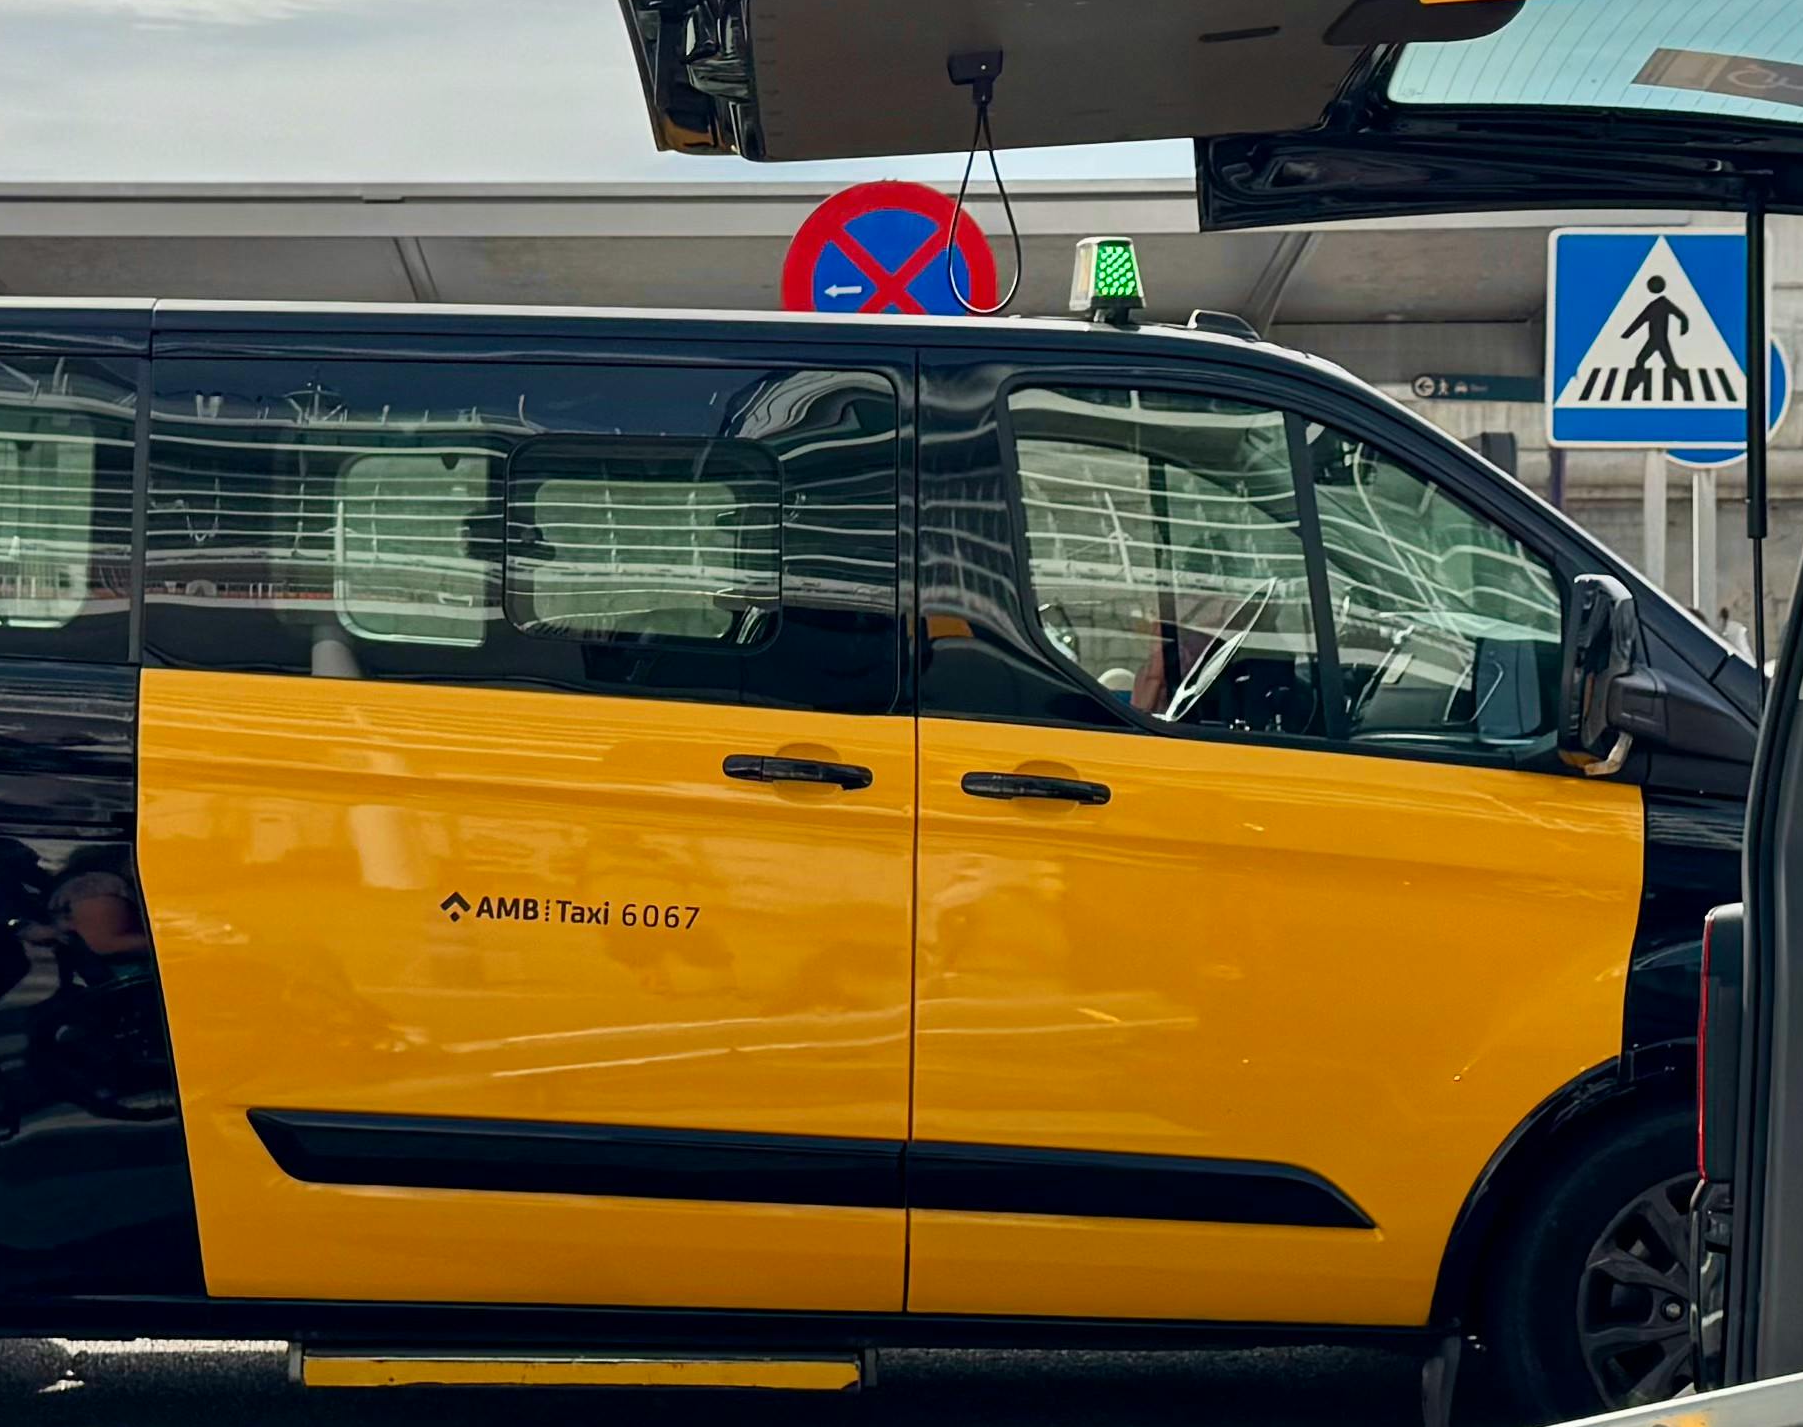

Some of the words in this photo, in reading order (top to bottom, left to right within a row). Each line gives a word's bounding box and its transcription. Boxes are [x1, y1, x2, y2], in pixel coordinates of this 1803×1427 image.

[475, 895, 539, 921] AMB
[555, 899, 610, 926] Taxi
[622, 903, 701, 930] 6067
